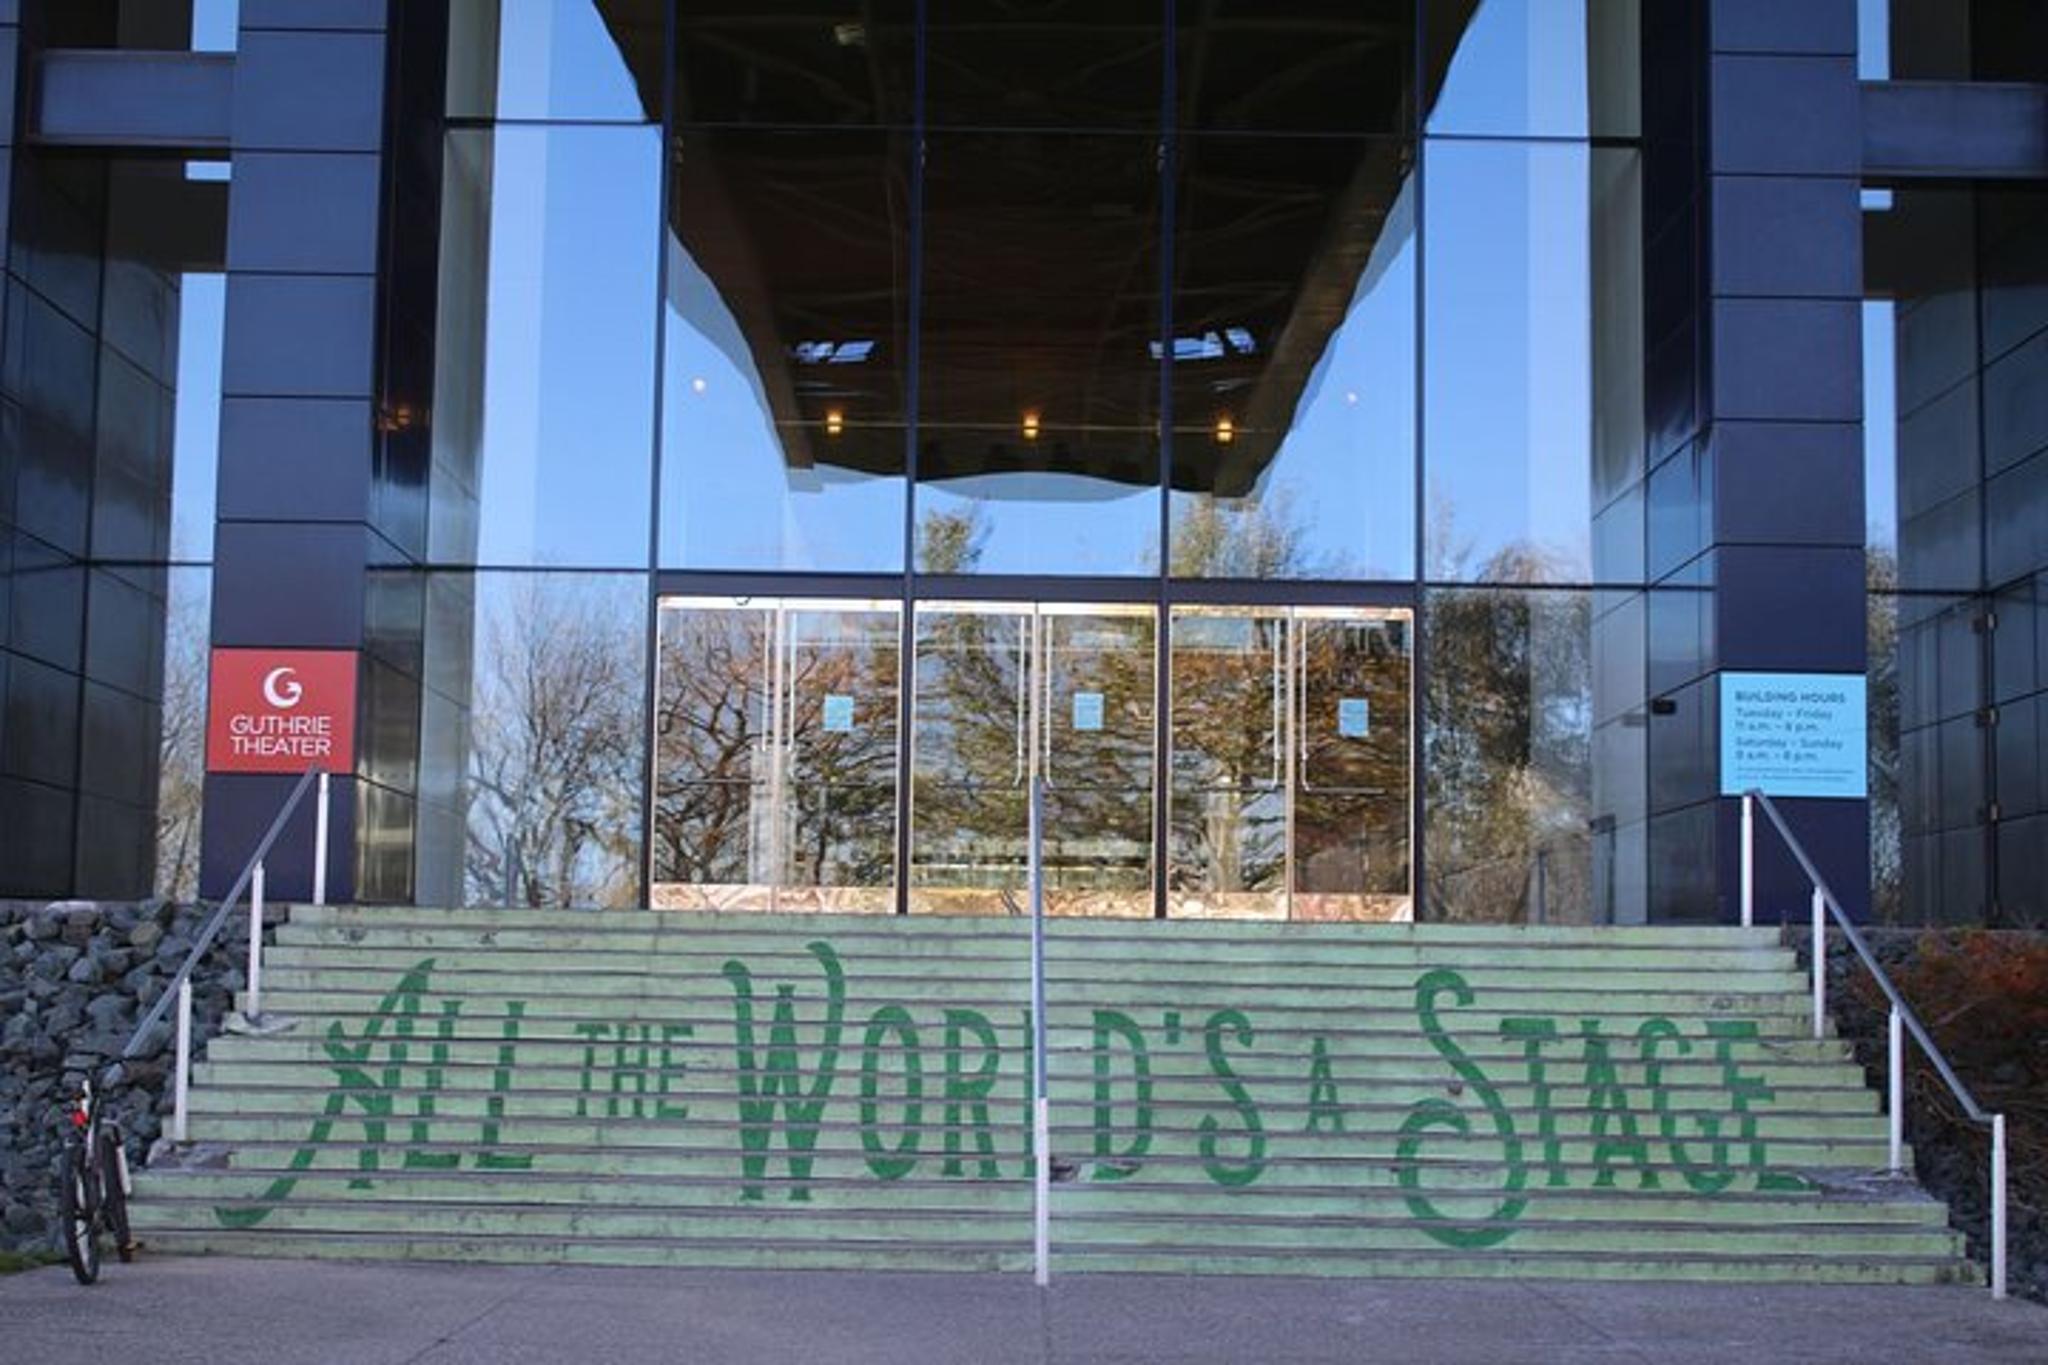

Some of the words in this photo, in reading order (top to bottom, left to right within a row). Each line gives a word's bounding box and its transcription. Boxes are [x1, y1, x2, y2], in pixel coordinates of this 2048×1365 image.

[1735, 691, 1798, 703] BUILDING
[1800, 692, 1846, 703] HOURS
[1736, 707, 1784, 719] Tuesday
[1796, 709, 1833, 721] Friday
[230, 715, 331, 736] GUTHRIE
[230, 736, 331, 757] THEATER
[1736, 736, 1787, 749] Saturday
[1800, 738, 1843, 751] Sunday
[213, 958, 533, 1228] ALL
[575, 1023, 694, 1120] THE
[1305, 1037, 1345, 1133] A
[1394, 969, 1824, 1249] STAGE
